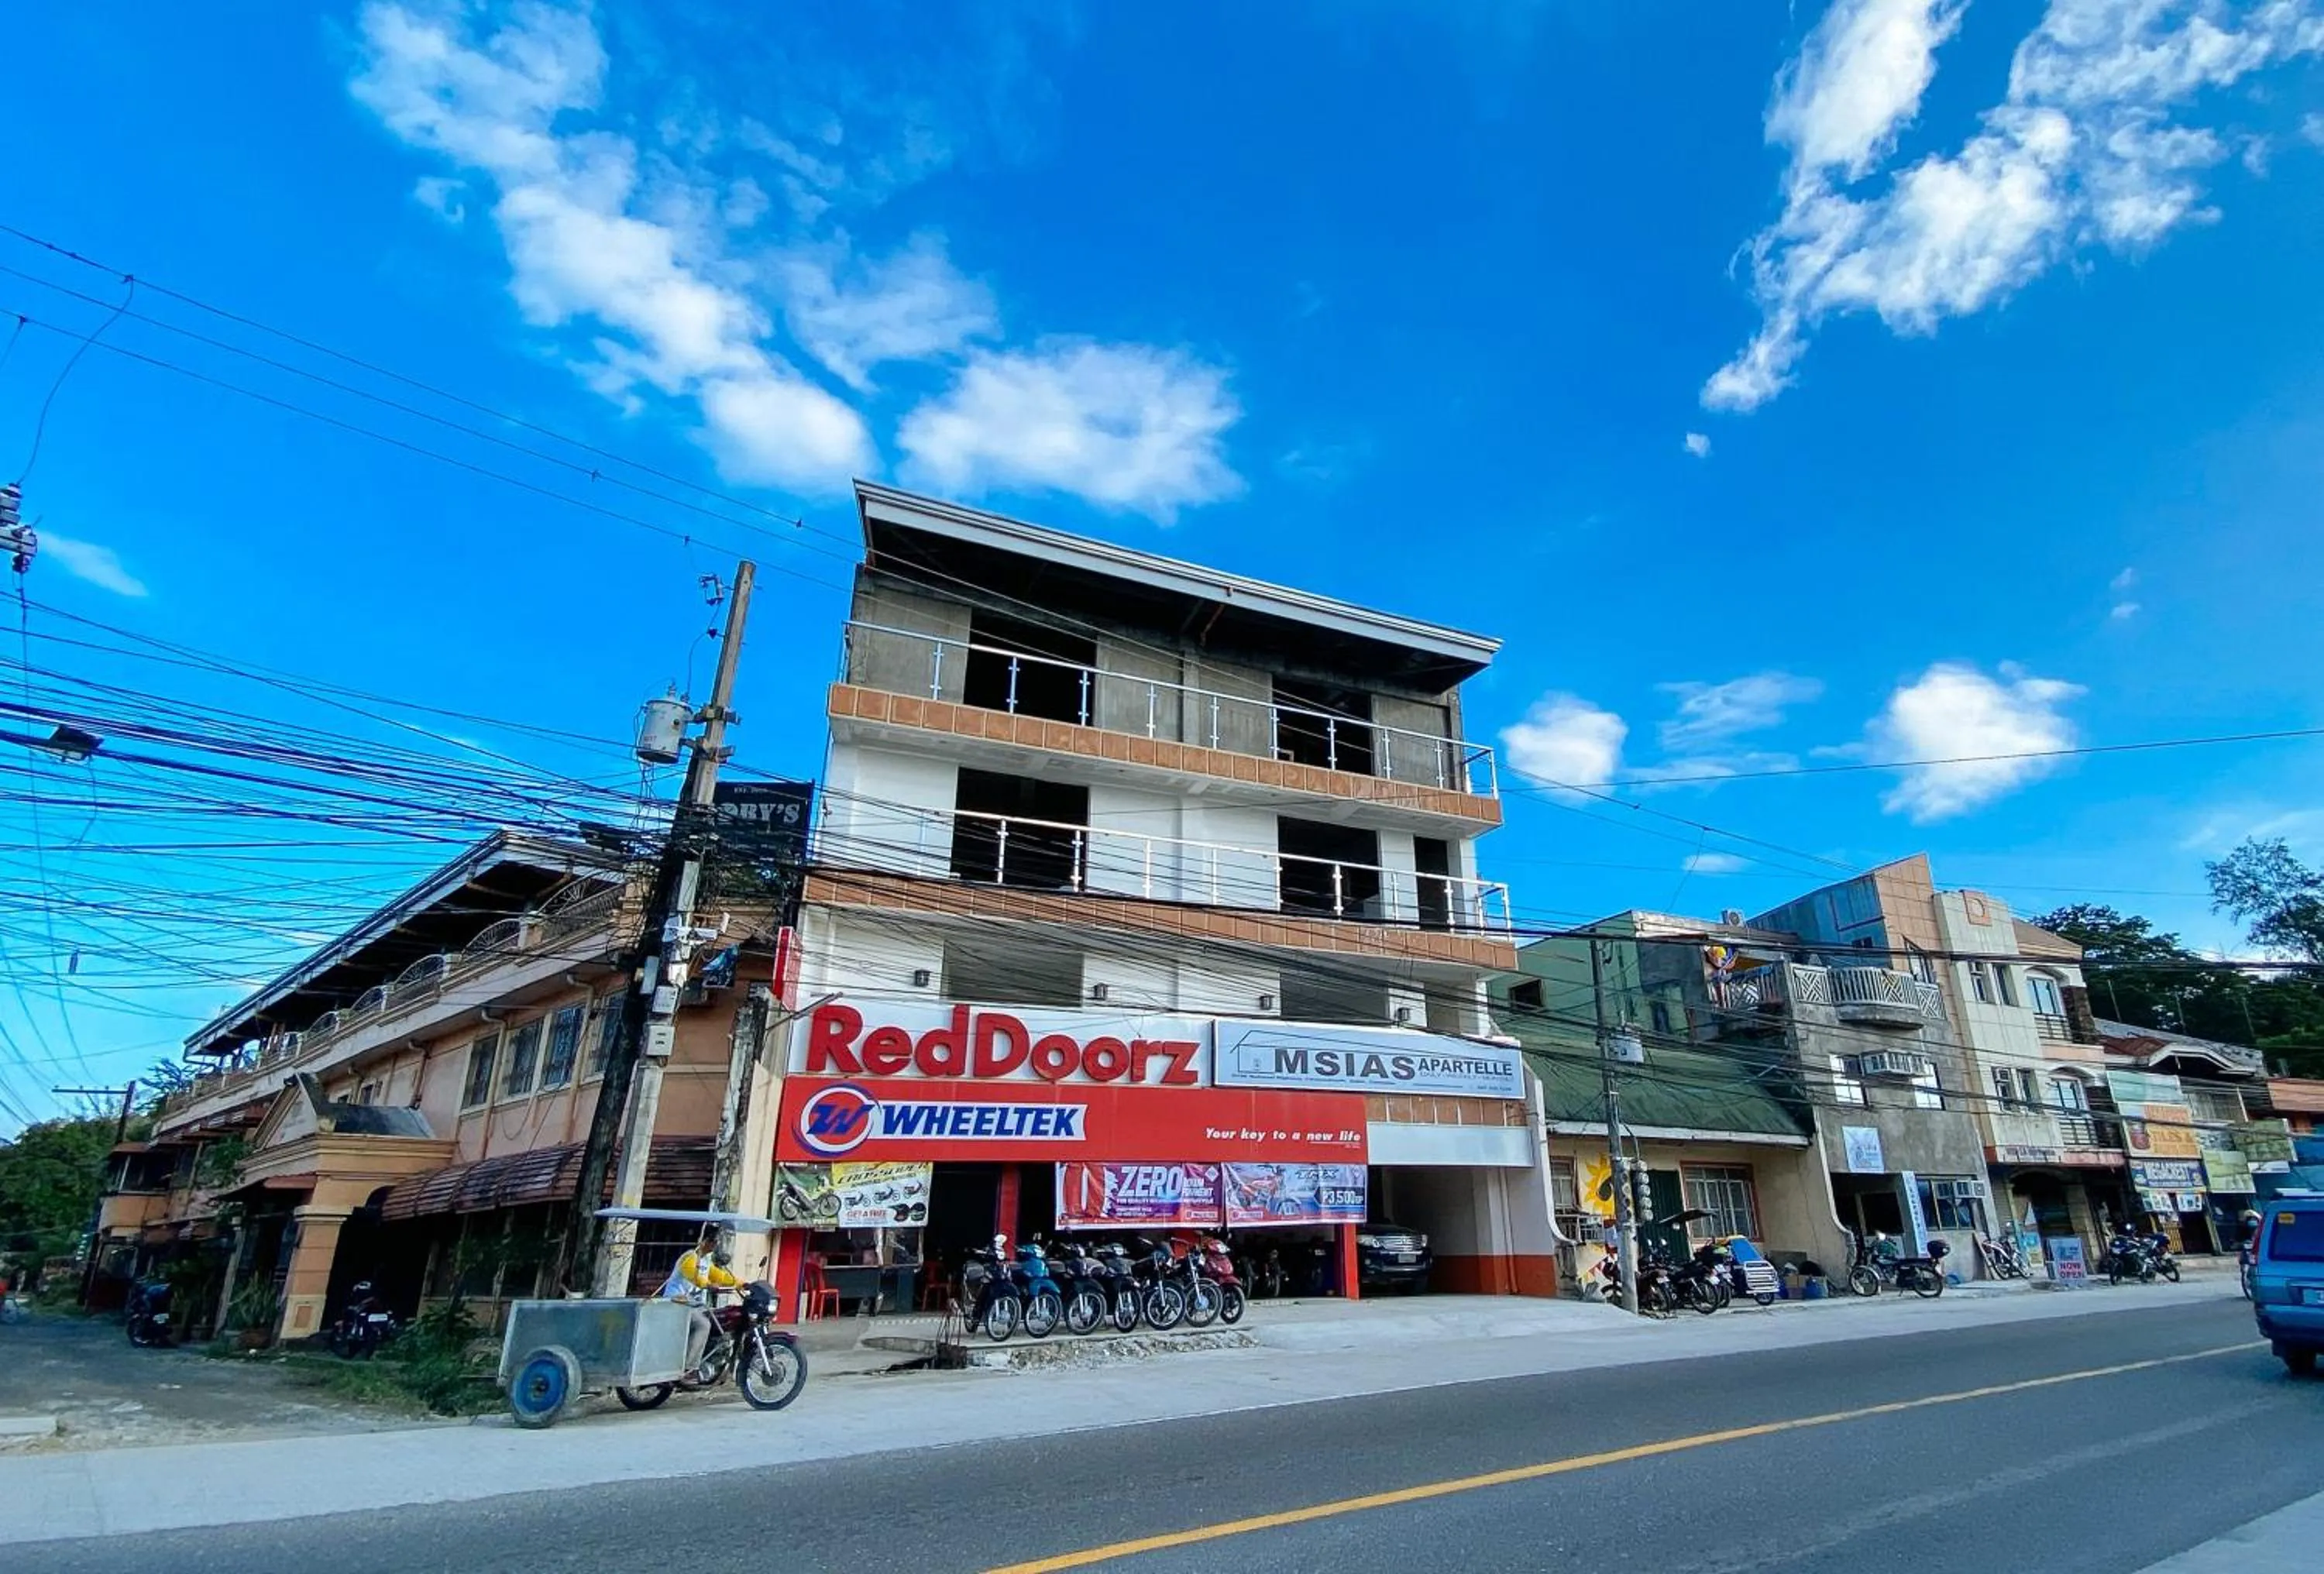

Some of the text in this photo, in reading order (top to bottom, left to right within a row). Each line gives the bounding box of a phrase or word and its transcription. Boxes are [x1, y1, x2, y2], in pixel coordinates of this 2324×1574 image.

[806, 1004, 1201, 1084] RedDoorz
[1274, 1048, 1416, 1081] MSIAS
[1418, 1057, 1513, 1076] APARTELLE
[882, 1105, 1079, 1137] WHEELTEK
[1205, 1127, 1362, 1143] Your key to a new life
[1117, 1166, 1184, 1199] ZERO
